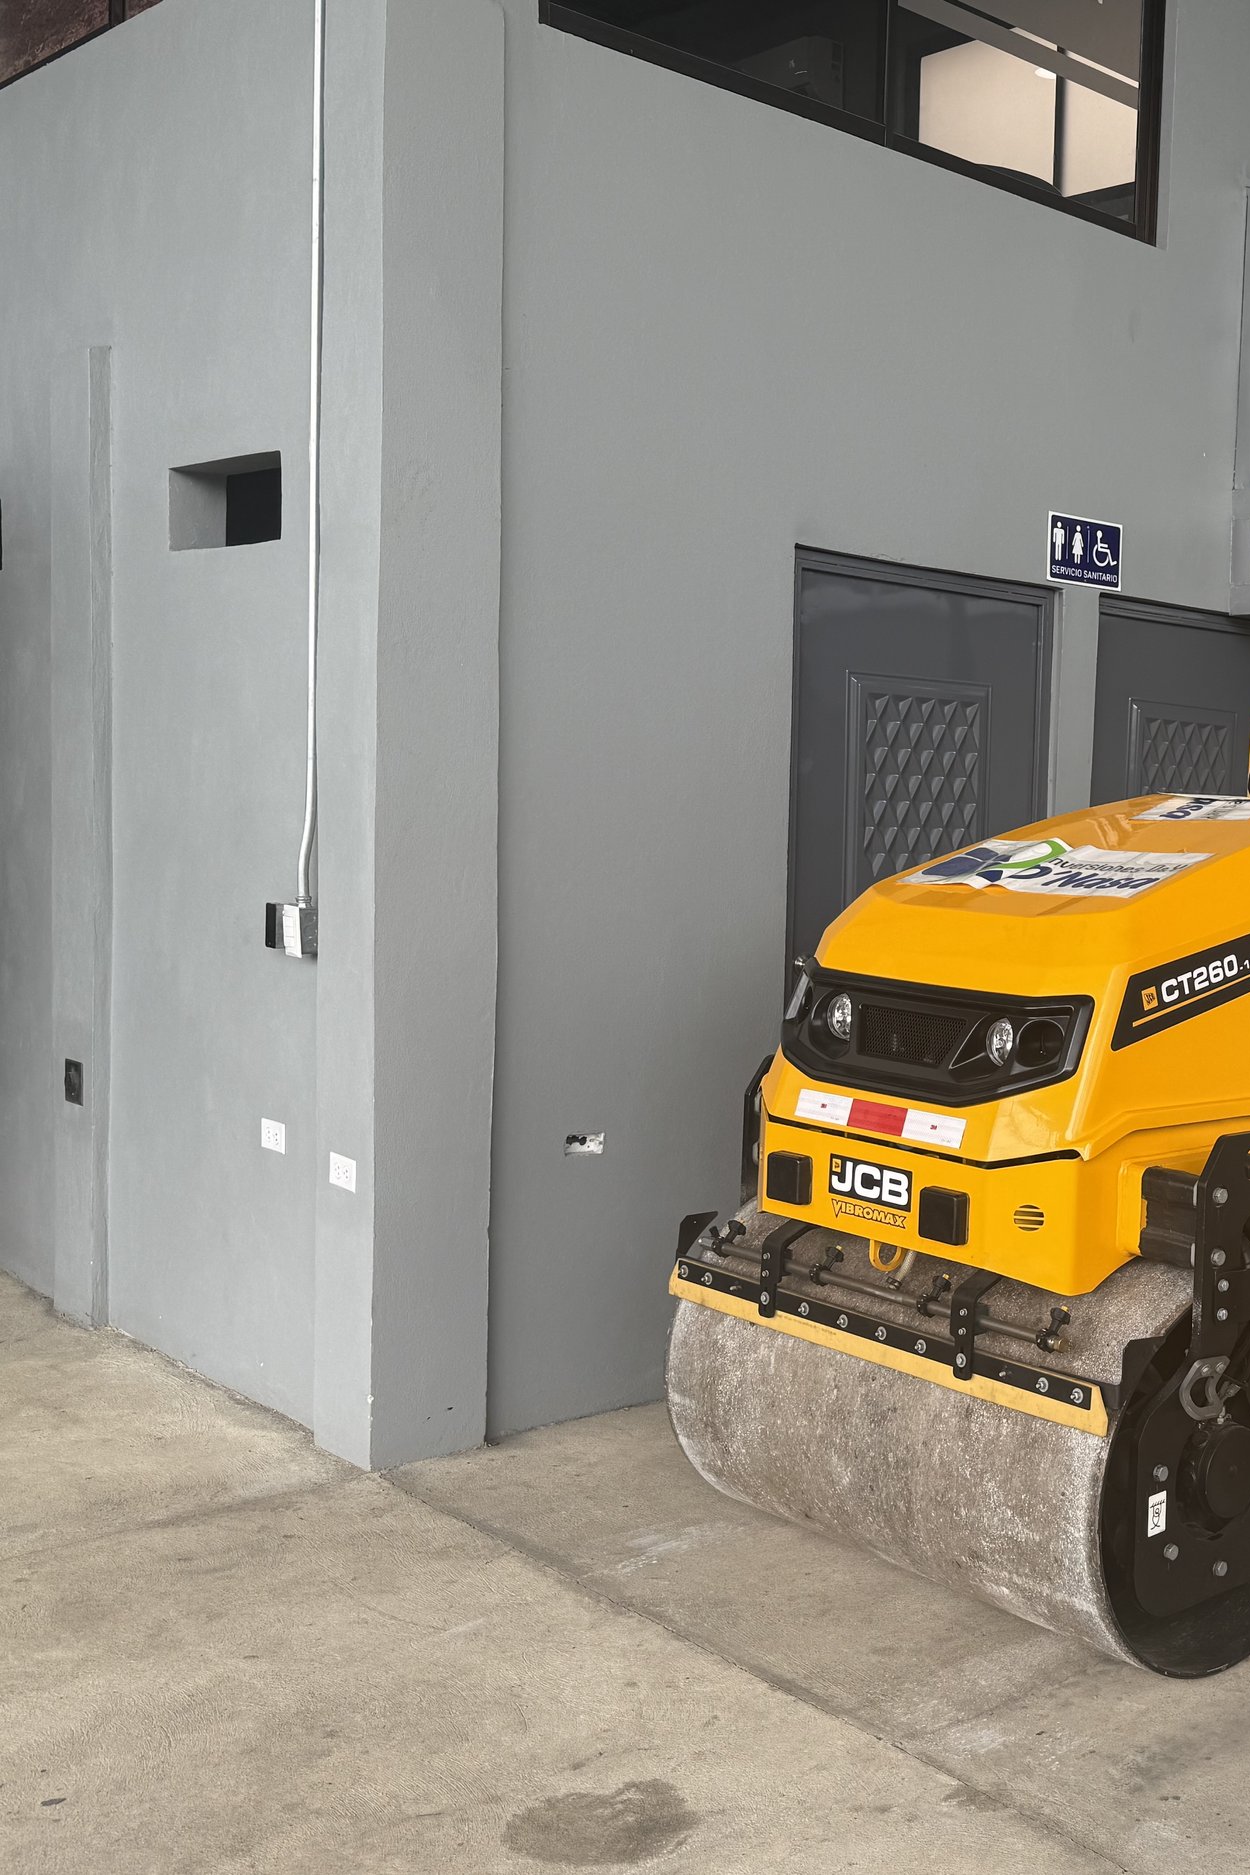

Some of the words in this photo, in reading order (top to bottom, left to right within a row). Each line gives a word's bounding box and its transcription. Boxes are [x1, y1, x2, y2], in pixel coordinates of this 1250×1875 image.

[1052, 565, 1082, 577] SERVICIO
[1083, 570, 1117, 583] SANITARIO
[1049, 856, 1144, 873] nversiones
[831, 1161, 909, 1206] JCB
[831, 1198, 906, 1229] VIBROMAX
